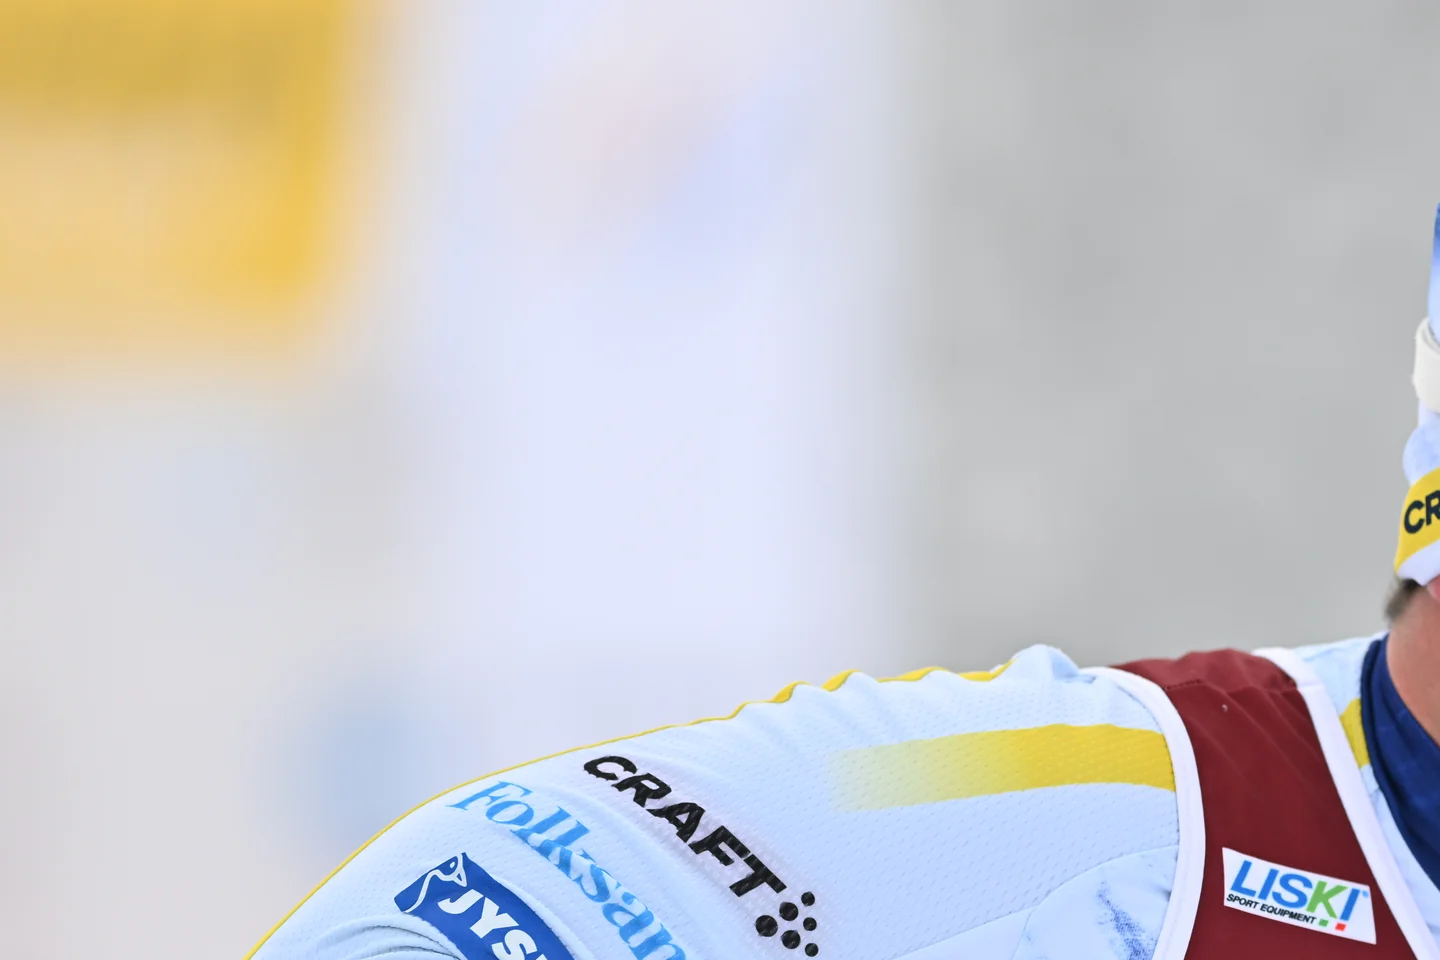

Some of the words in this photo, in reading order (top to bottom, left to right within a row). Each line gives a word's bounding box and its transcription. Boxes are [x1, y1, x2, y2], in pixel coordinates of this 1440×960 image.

[582, 755, 787, 898] CRAFT
[1226, 893, 1260, 910] SPORT
[1259, 903, 1318, 925] EQUIPMENT
[1230, 859, 1361, 922] LISKI
